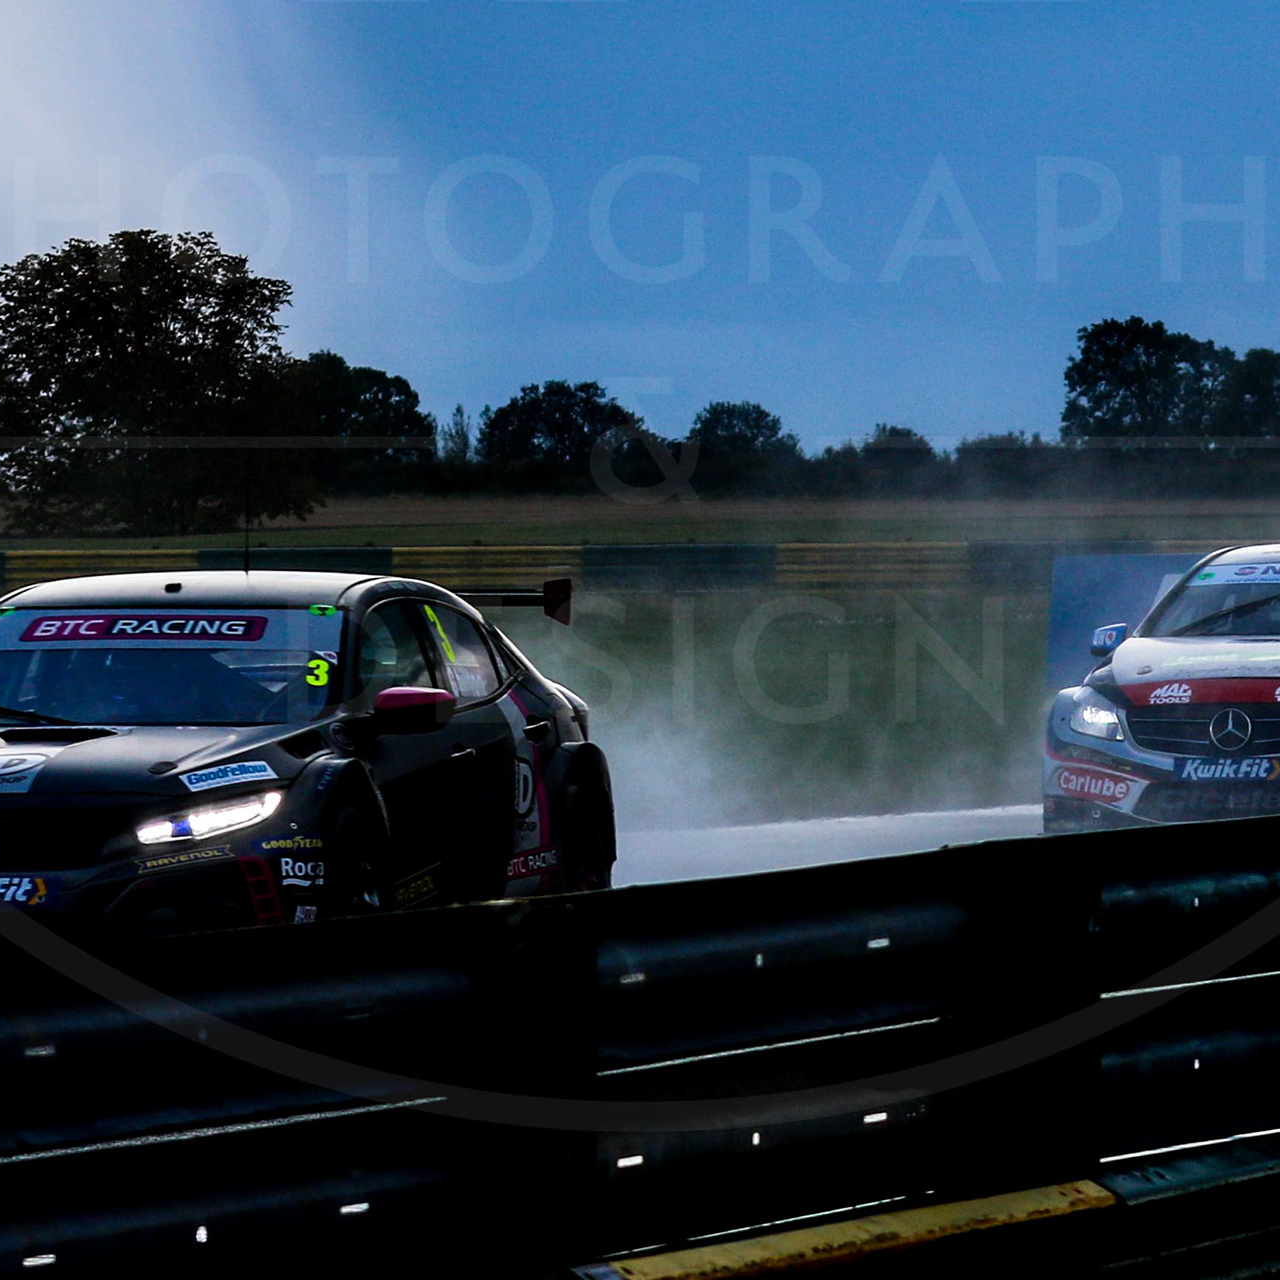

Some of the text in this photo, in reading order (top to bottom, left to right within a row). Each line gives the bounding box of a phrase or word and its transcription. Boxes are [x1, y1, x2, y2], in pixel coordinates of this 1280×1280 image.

[33, 619, 248, 636] BTC RACING
[424, 604, 455, 663] 3
[305, 659, 329, 686] 3
[1150, 683, 1192, 697] MAC
[1148, 697, 1190, 705] TOOLS
[1059, 770, 1129, 800] Carlube
[146, 850, 223, 868] RAVENOL
[280, 857, 324, 876] Roca
